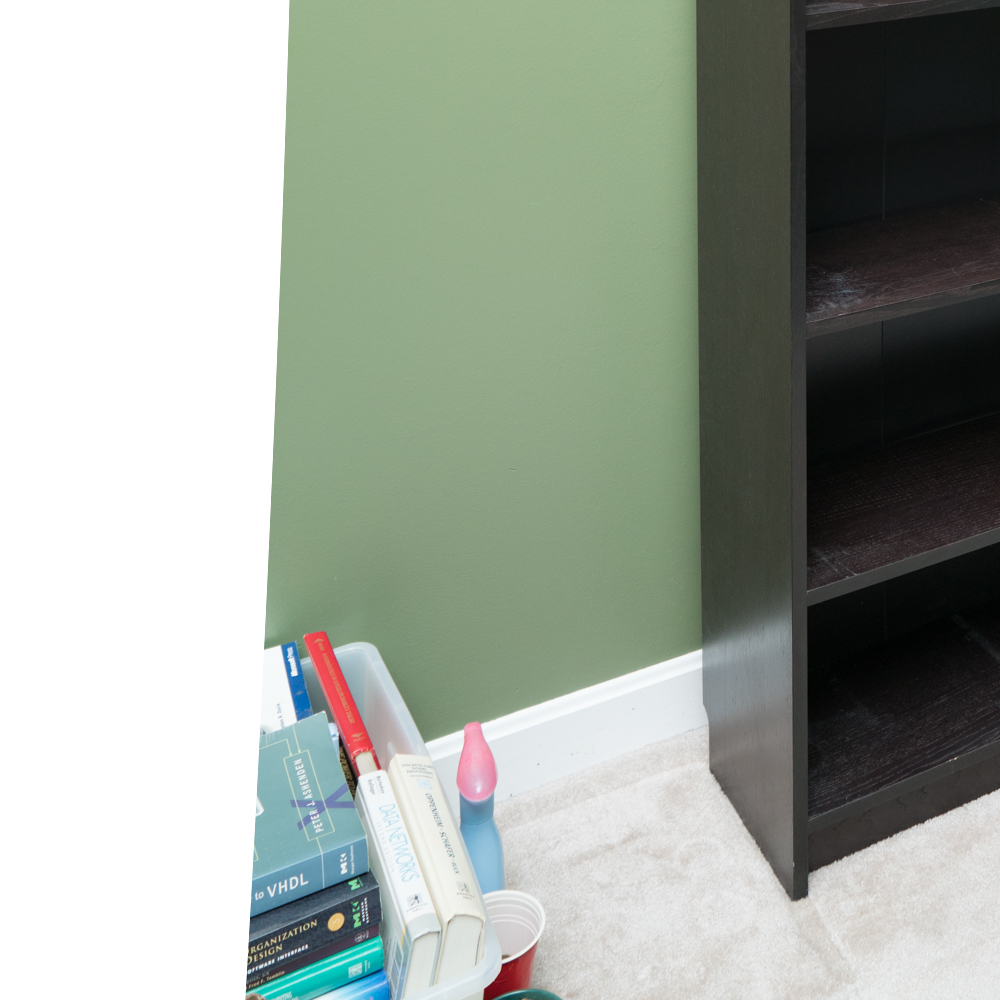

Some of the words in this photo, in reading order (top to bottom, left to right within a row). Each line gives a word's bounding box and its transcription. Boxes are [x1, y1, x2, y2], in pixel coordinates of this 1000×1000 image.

[294, 758, 313, 800] ASHENDEN
[309, 809, 324, 833] PETER
[379, 804, 400, 828] DATA
[425, 793, 444, 828] OPPENHEIM
[387, 826, 420, 882] NETWORKS
[254, 891, 264, 900] to
[267, 874, 308, 898] VHDL
[277, 944, 309, 962] INTERFACE
